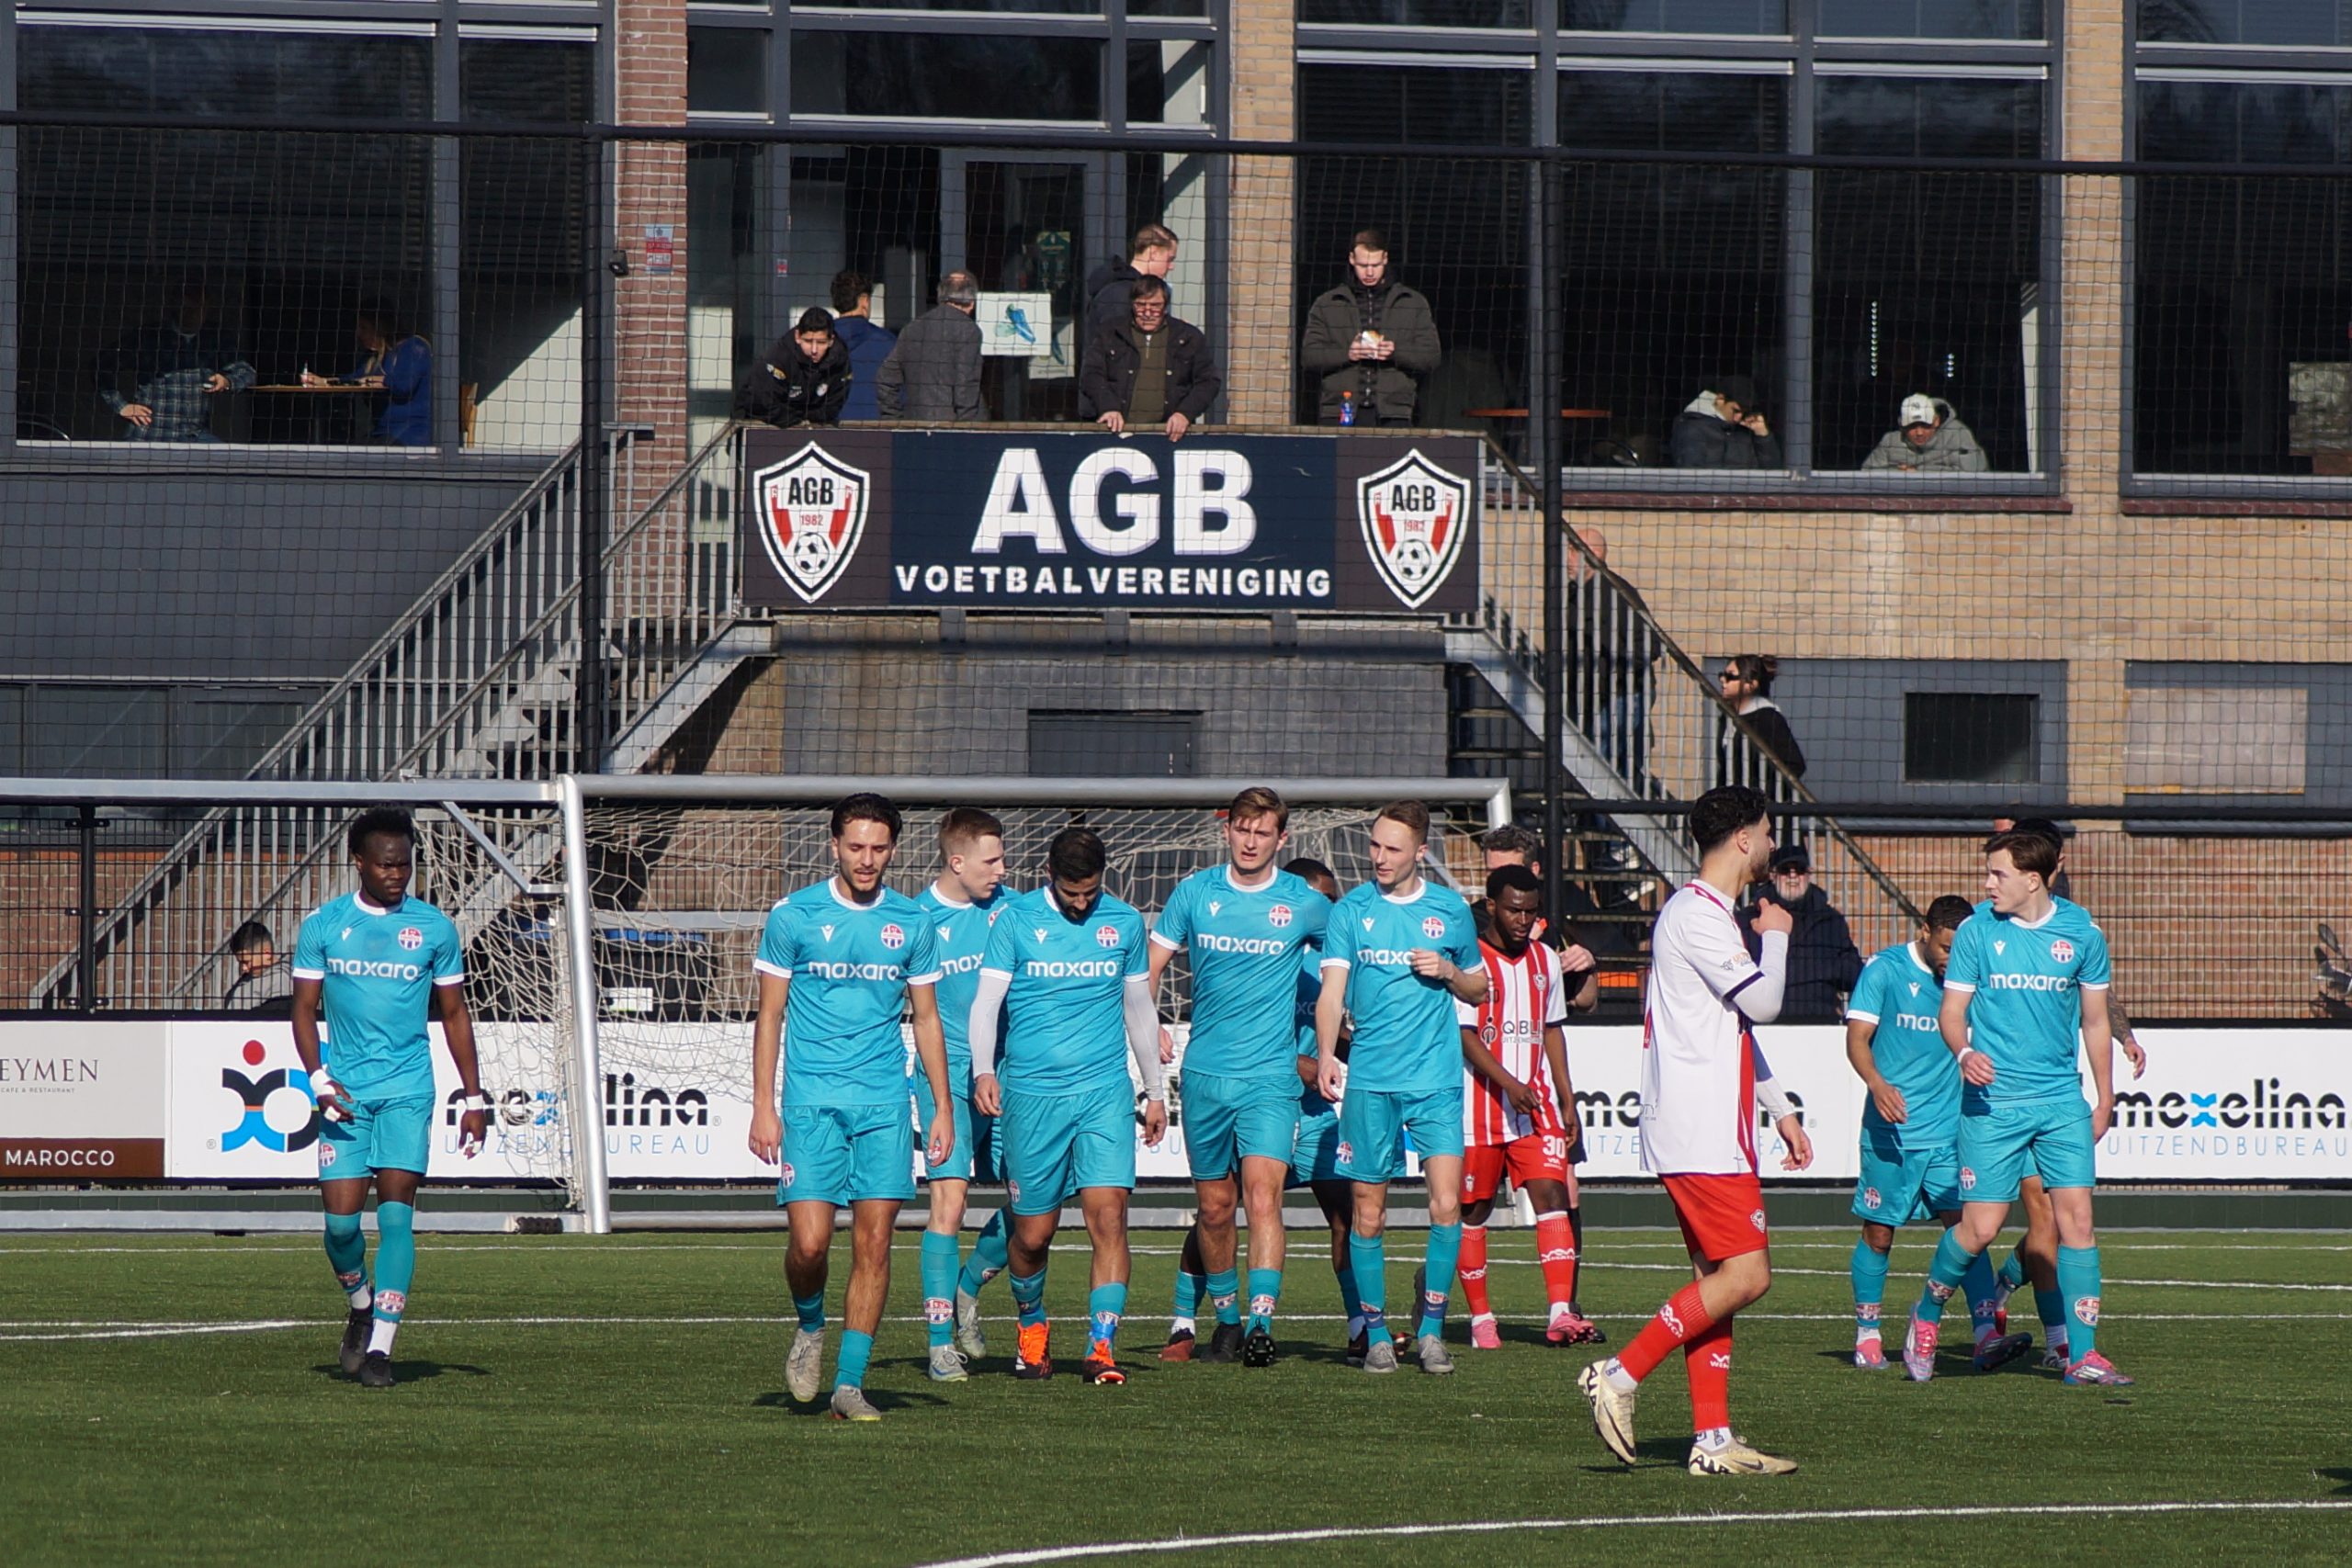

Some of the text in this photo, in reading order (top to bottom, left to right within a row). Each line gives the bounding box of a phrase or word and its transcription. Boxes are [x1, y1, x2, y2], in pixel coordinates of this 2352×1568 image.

[788, 477, 833, 505] AGB
[971, 446, 1258, 556] AGB
[1391, 484, 1436, 512] AGB
[801, 514, 824, 526] 1982
[1404, 520, 1425, 532] 1982
[895, 564, 1331, 597] VOETBALVERENIGING
[1197, 933, 1284, 954] maxaro
[327, 958, 419, 981] maxaro
[808, 961, 900, 981] maxaro
[940, 953, 984, 976] max
[1027, 961, 1117, 977] maxaro
[1989, 974, 2069, 992] maxaro
[1896, 1012, 1940, 1032] max
[2110, 1077, 2346, 1129] mexelina
[1543, 1134, 1566, 1159] 30
[2107, 1134, 2347, 1156] UITZENDBUREAU
[6, 1150, 115, 1166] MAROCCO
